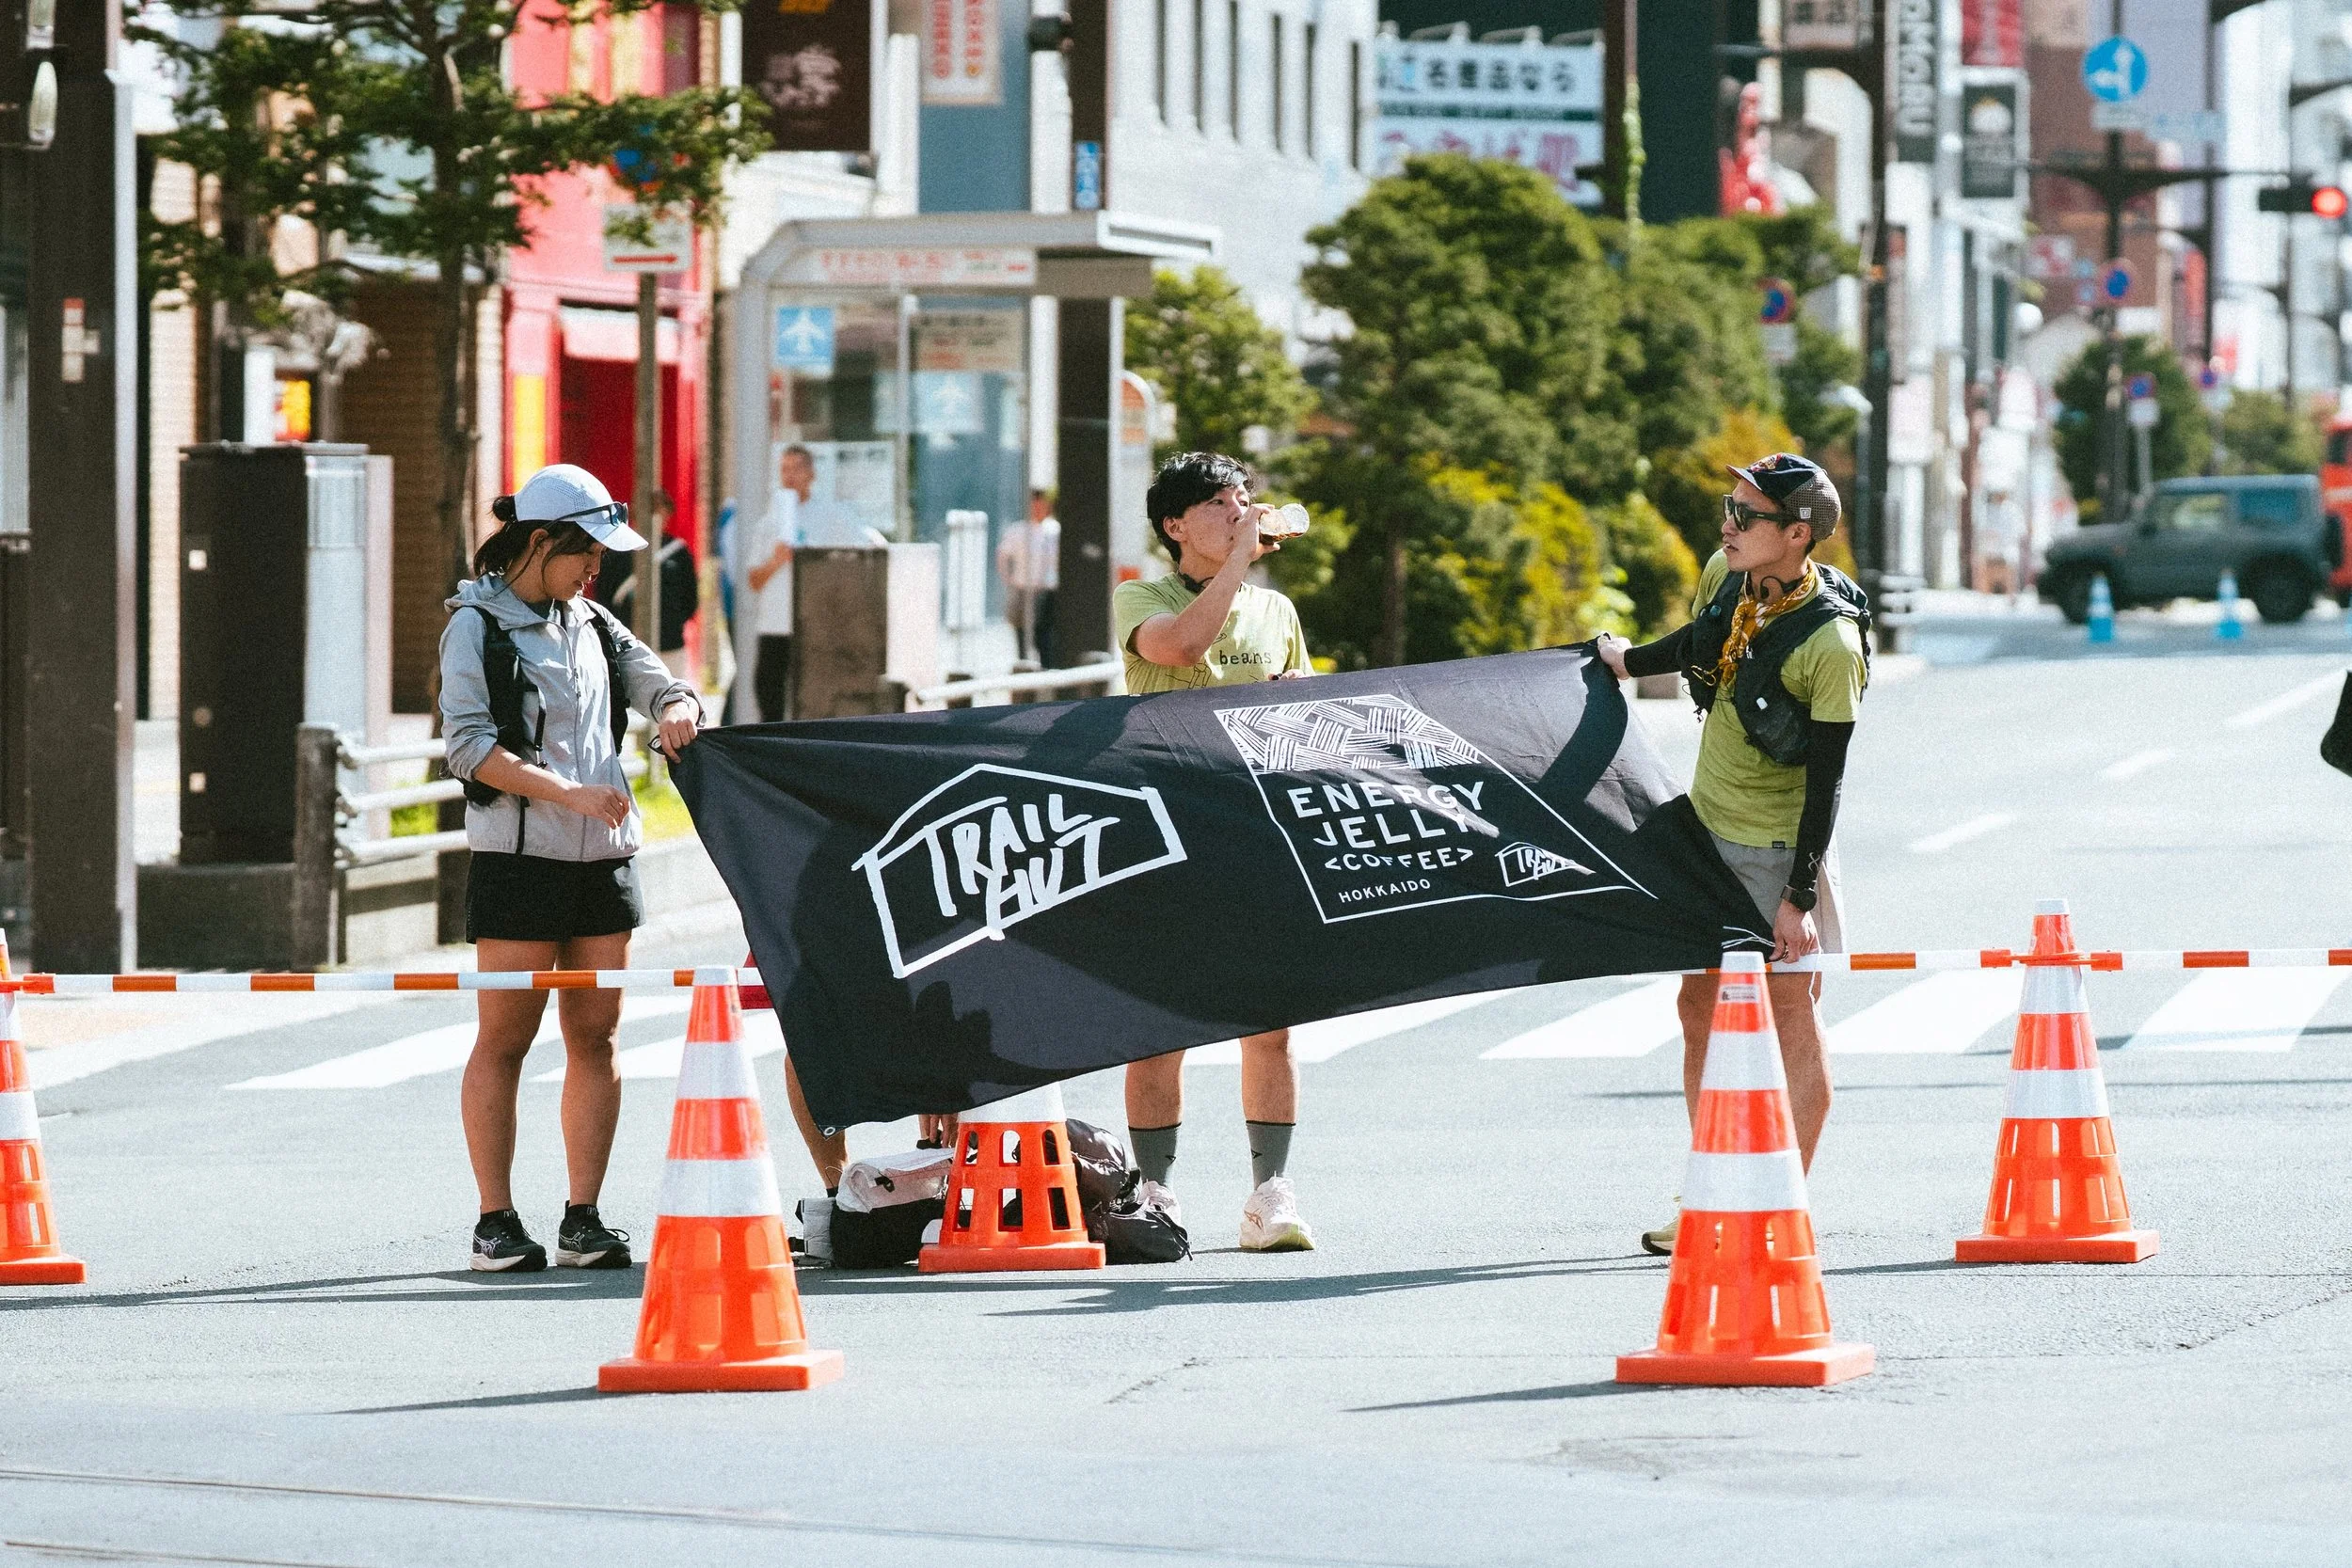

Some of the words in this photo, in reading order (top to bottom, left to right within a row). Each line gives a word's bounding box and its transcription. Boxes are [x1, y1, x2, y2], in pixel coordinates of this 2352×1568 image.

[1219, 649, 1272, 665] beans
[1287, 781, 1485, 819] ENERGY
[1313, 808, 1470, 848] JELLY
[914, 794, 1093, 917] TRAIL
[985, 816, 1120, 941] HUT
[1339, 878, 1432, 903] HOKKAIDO
